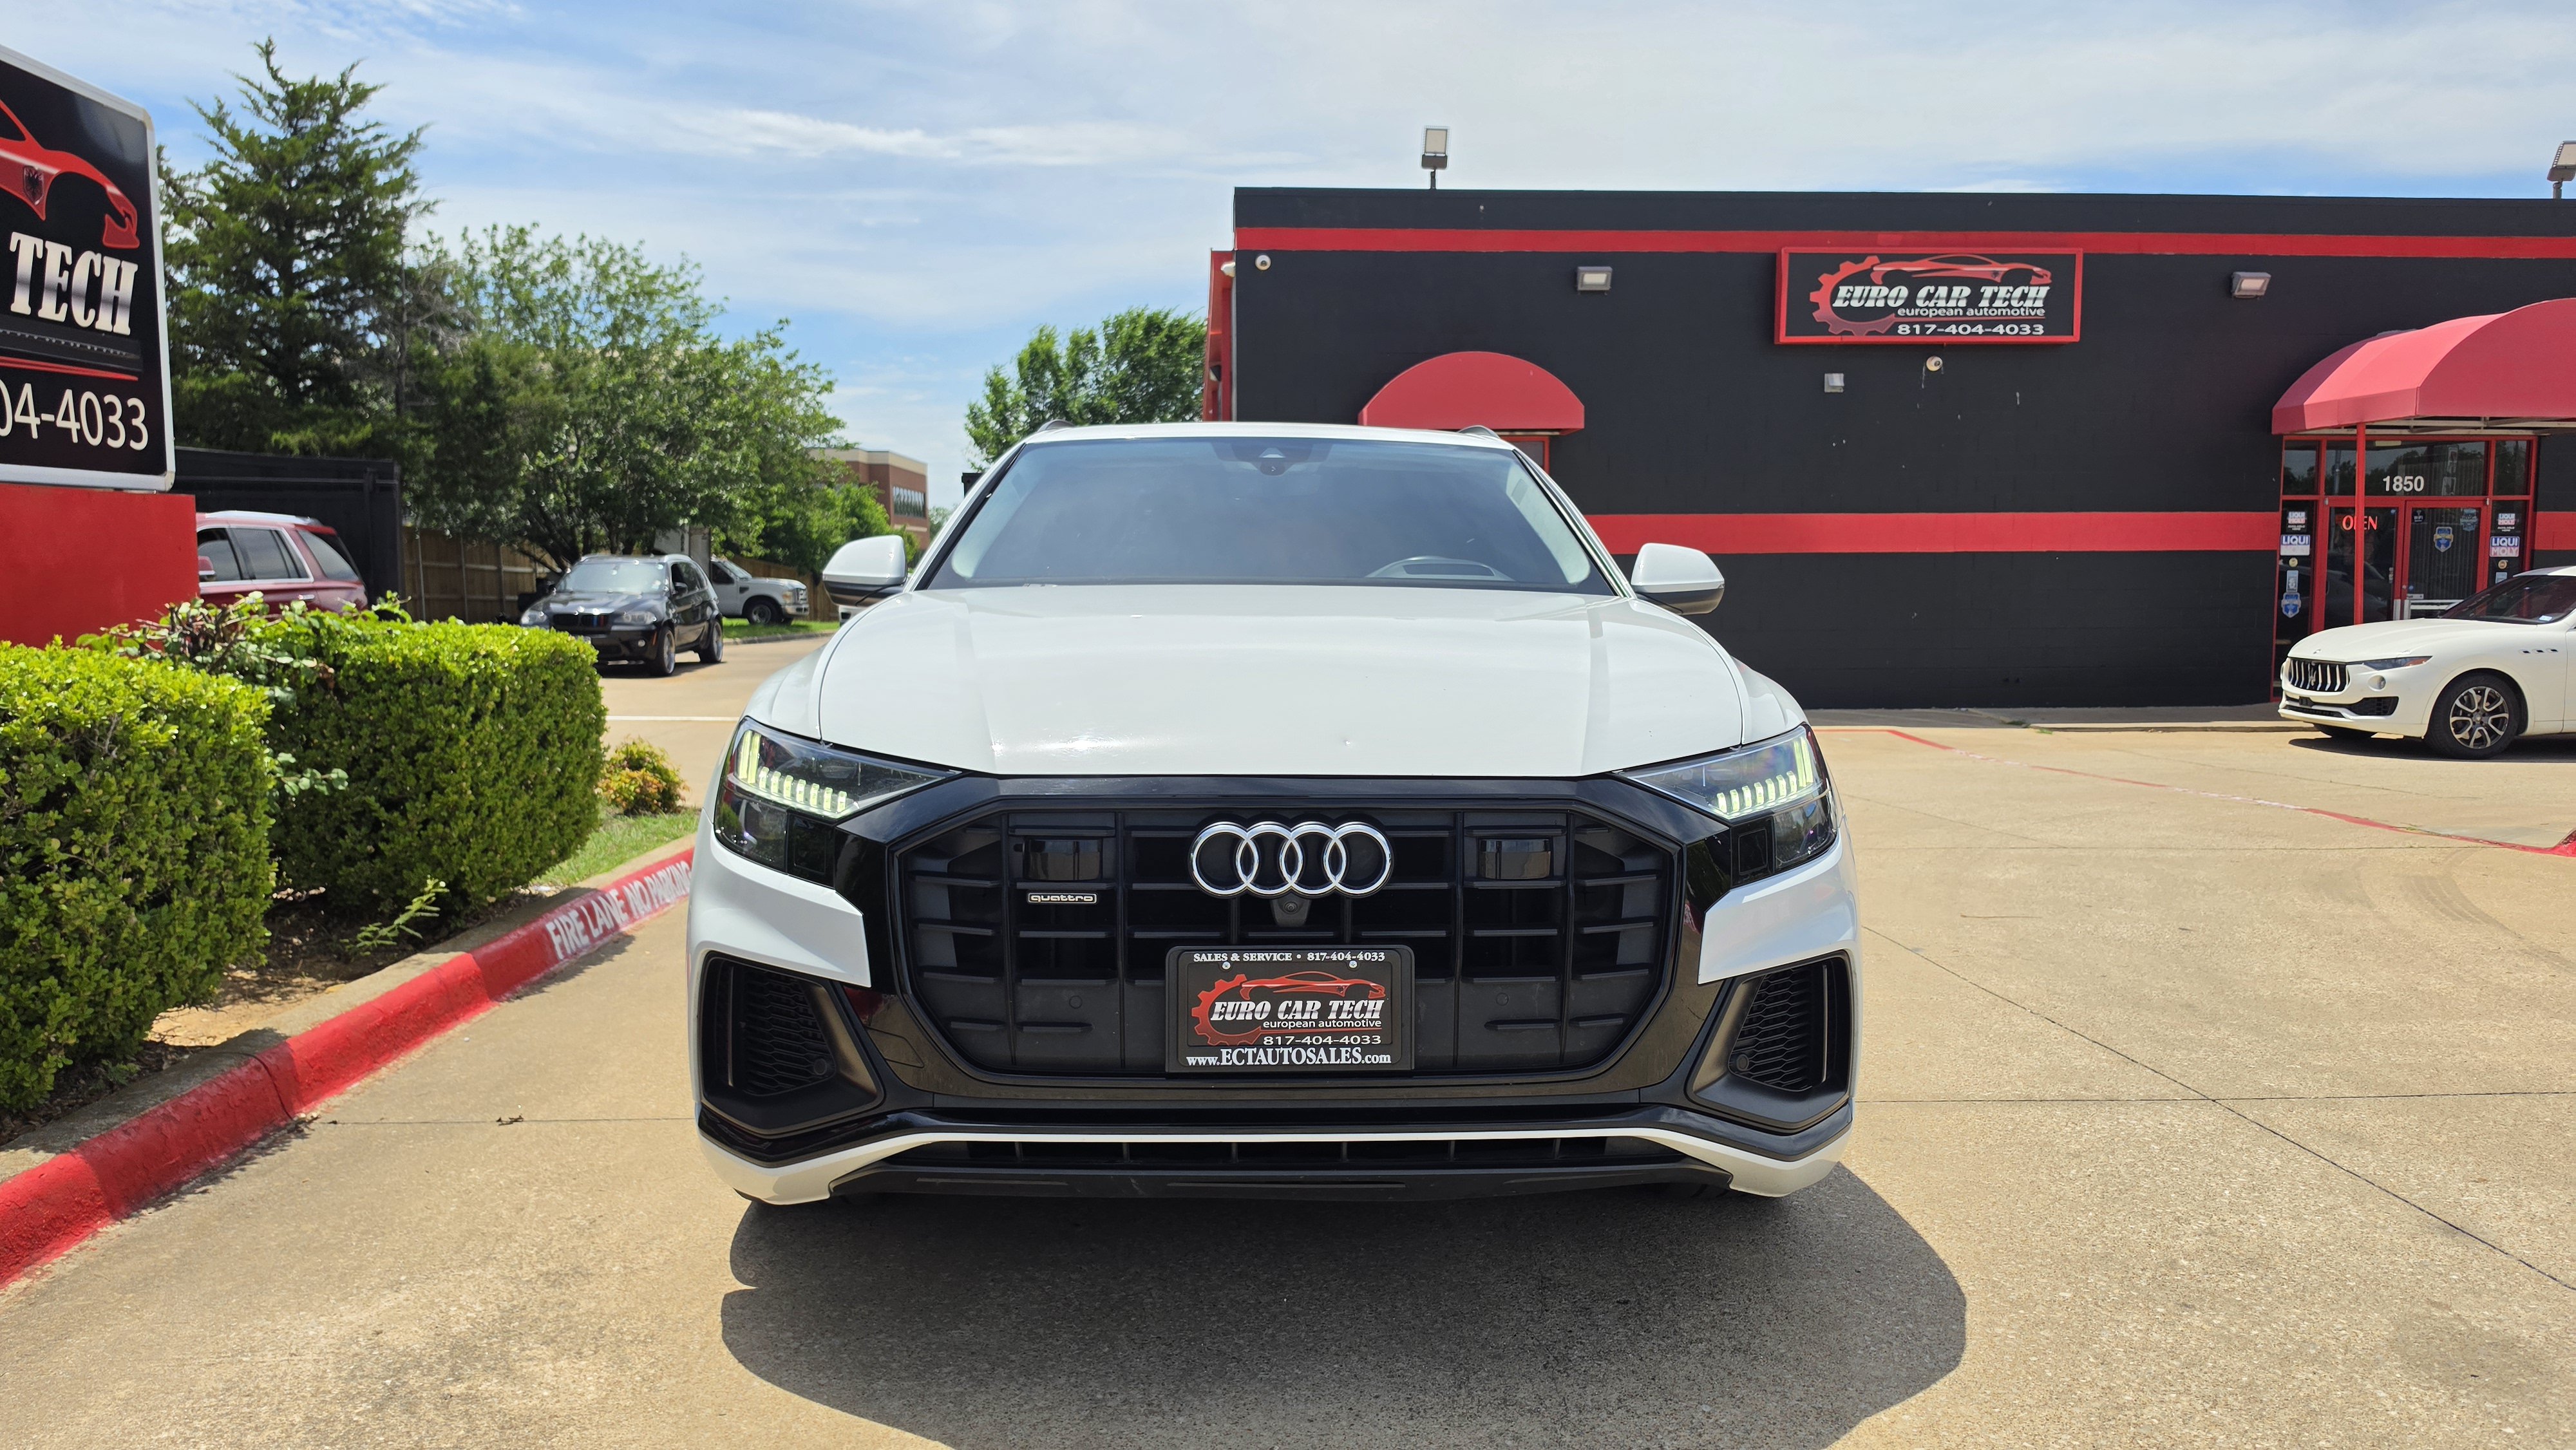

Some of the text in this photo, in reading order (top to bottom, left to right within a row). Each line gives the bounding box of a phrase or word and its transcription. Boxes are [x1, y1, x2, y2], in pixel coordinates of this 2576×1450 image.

[10, 231, 138, 335] TECH
[1832, 286, 2050, 307] EURO CAR TECH
[1897, 306, 2045, 317] european automotive
[1897, 324, 2045, 335] 817-404-4033
[2383, 476, 2424, 492] 1850
[2282, 535, 2309, 545] LIQUI
[2492, 538, 2518, 547] LIQUI
[2491, 547, 2518, 556] MOLY
[545, 909, 591, 960] FIRE
[580, 889, 629, 938] LANE
[622, 880, 652, 919] NO
[1193, 952, 1385, 962] SALES & SERVICE 817-404-4033
[1210, 1000, 1385, 1021] EURO CAR TECH
[1263, 1019, 1382, 1030] european automotive
[1264, 1035, 1381, 1045] 817-404-4033
[1186, 1047, 1392, 1066] www.ECTAUTOSALES.com
